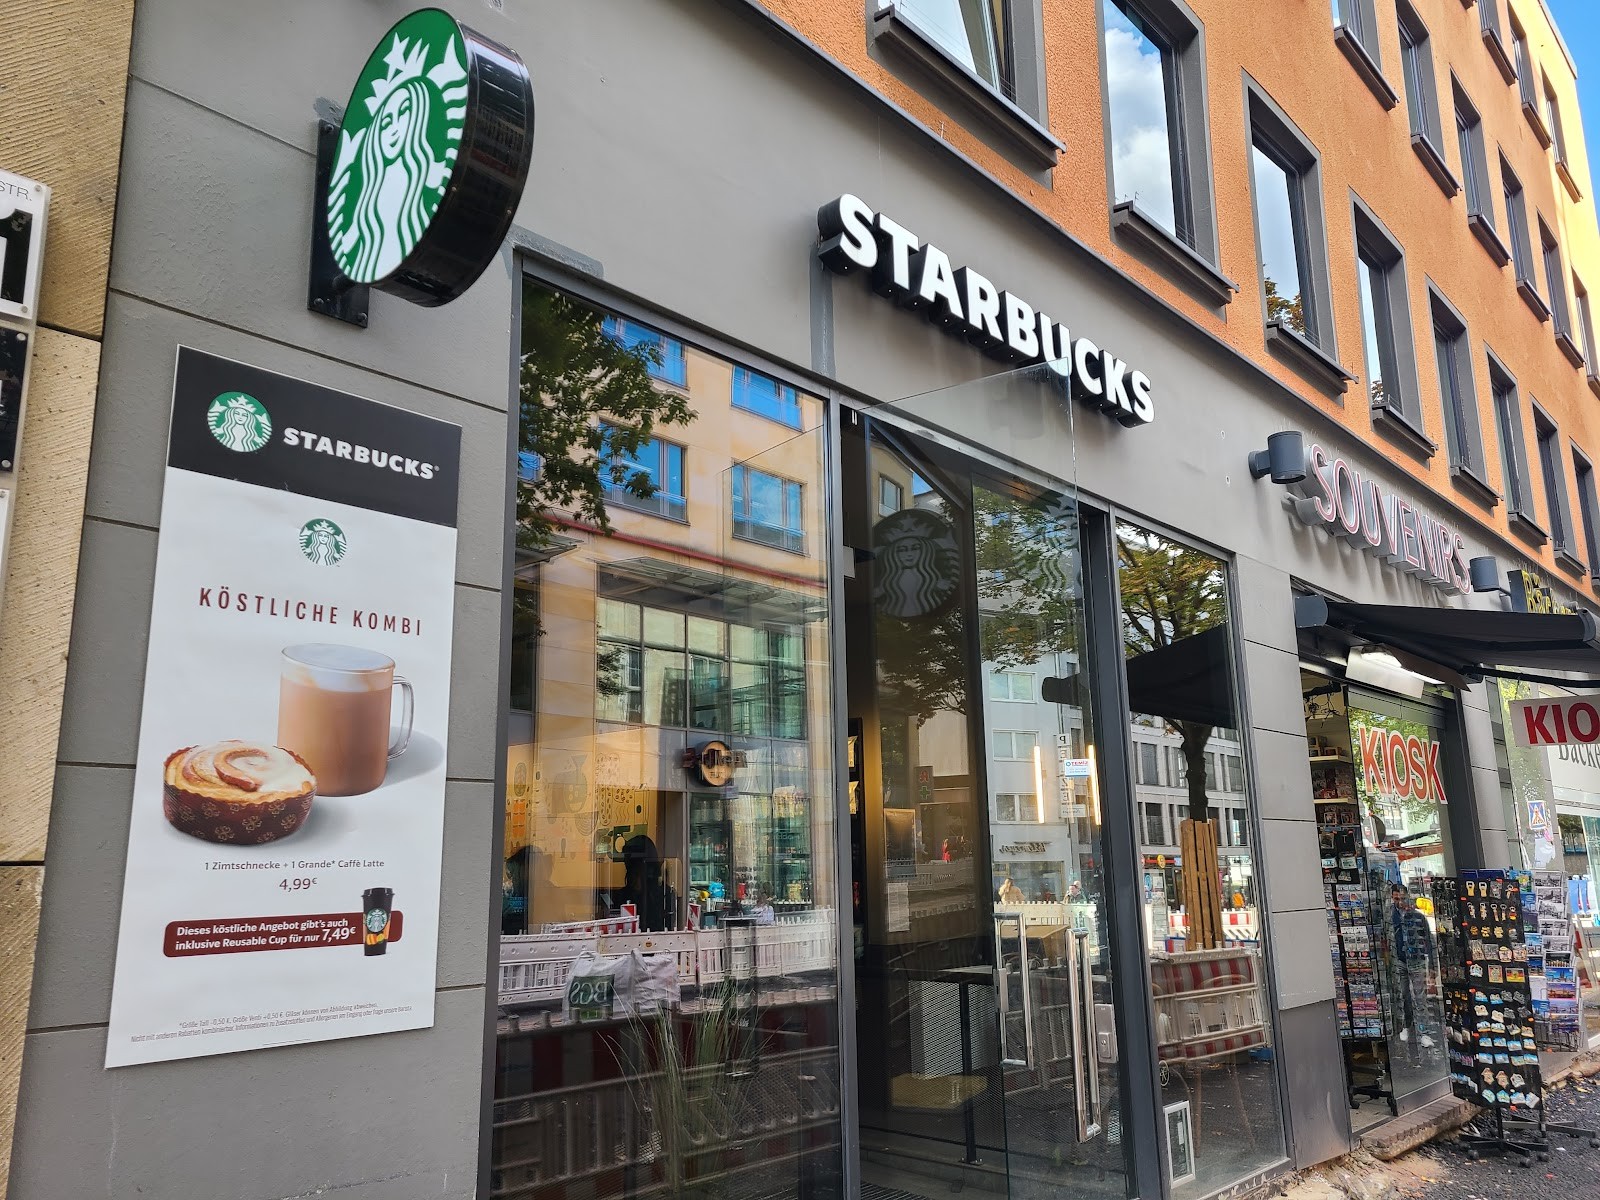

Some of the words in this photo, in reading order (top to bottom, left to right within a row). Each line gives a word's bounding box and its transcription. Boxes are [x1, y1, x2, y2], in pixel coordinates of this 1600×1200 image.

[832, 193, 1155, 424] STARBUCKS
[283, 427, 435, 480] STARBUCKS
[1308, 443, 1471, 595] SOUVENIRS
[199, 586, 339, 625] KÖSTLICHE
[353, 609, 422, 636] KOMBI
[1523, 702, 1600, 745] KIO
[1358, 724, 1448, 804] KIOSK
[204, 862, 209, 870] 1
[212, 861, 280, 871] Zimtschnecke
[291, 861, 295, 869] 1
[363, 859, 385, 868] Latte
[175, 939, 221, 951] inklusive
[222, 937, 267, 948] Reusable
[268, 935, 287, 946] Cup
[289, 934, 303, 943] für
[304, 933, 321, 942] nur
[177, 926, 211, 936] Dieses
[212, 923, 257, 935] köstliche
[258, 922, 299, 933] Angebot
[327, 918, 348, 928] auch
